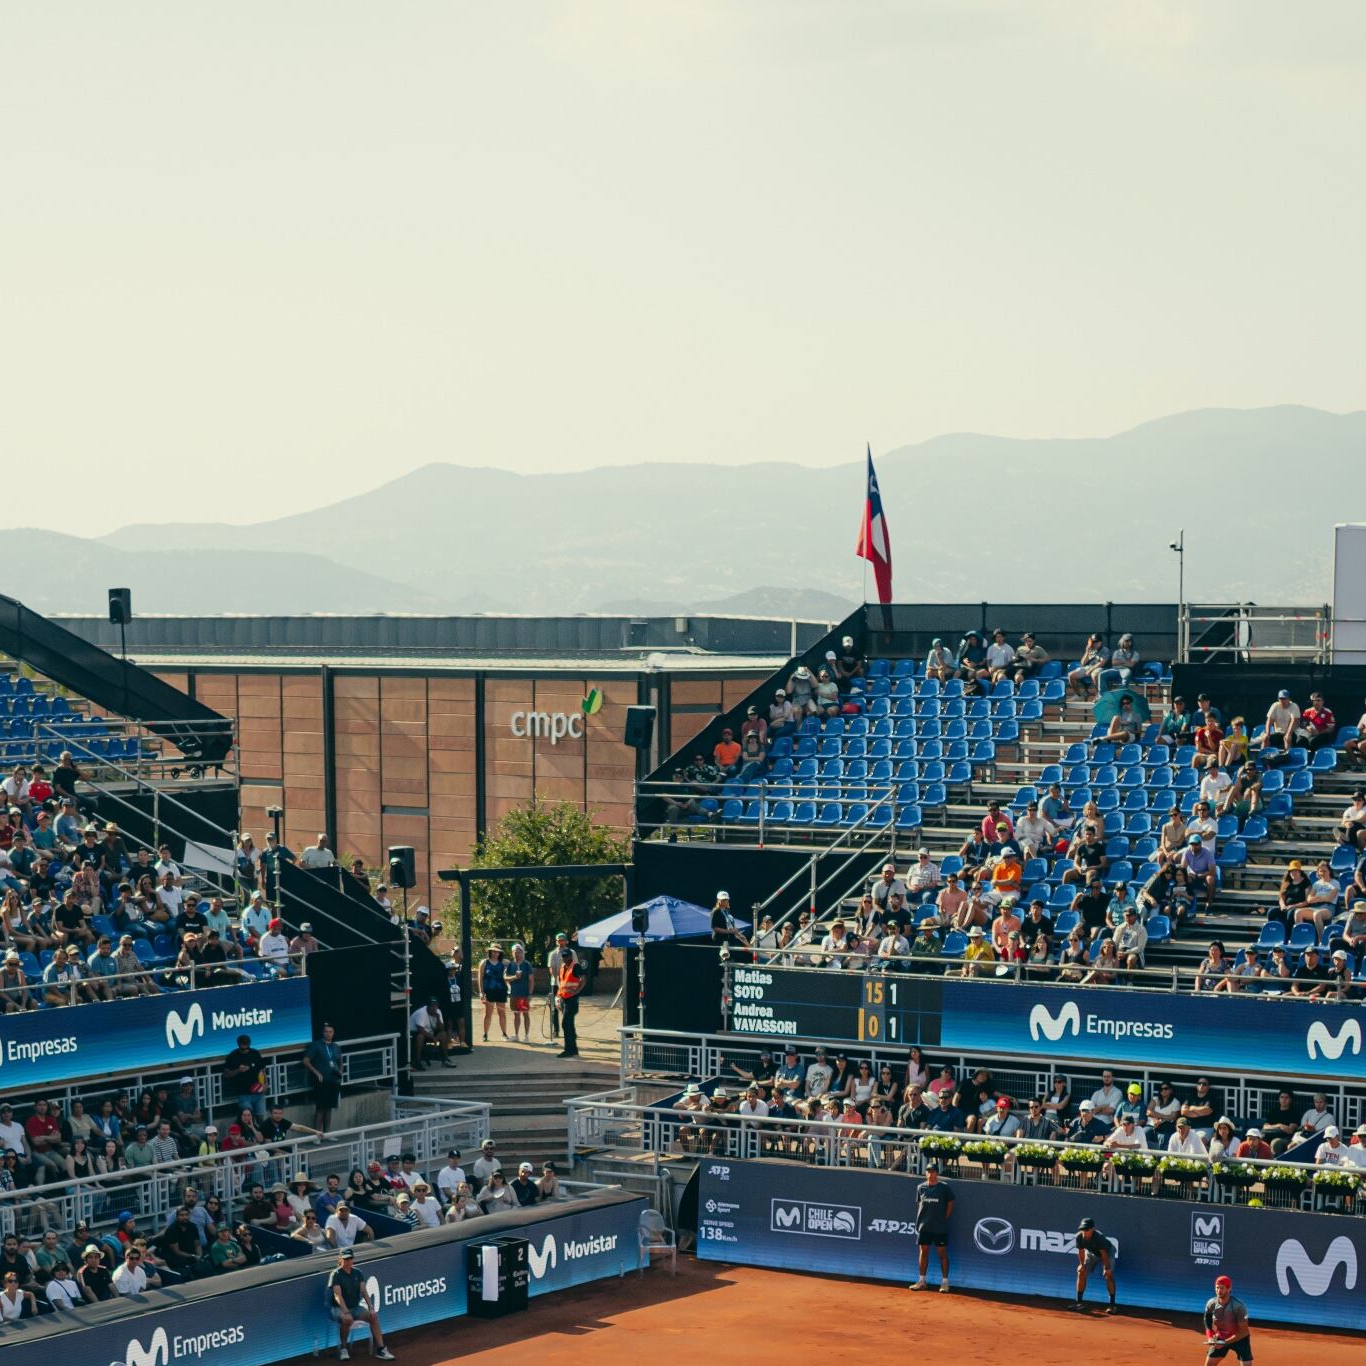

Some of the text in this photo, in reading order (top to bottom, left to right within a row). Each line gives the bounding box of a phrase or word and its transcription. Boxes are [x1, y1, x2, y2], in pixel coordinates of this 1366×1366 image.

[511, 711, 583, 746] cmpc
[735, 969, 773, 985] Matias
[734, 981, 897, 1005] SOTO 15 1
[211, 1007, 273, 1031] Movistar
[734, 1002, 773, 1018] Andrea
[734, 1015, 897, 1039] VAVASSORI 0 1
[1086, 1014, 1174, 1041] Empresas
[7, 1036, 78, 1063] Empresas
[708, 1166, 730, 1175] ATP
[808, 1207, 833, 1220] CHILE
[808, 1219, 833, 1231] OPEN
[563, 1234, 618, 1261] Movistar
[385, 1277, 447, 1306] Empresas
[173, 1325, 245, 1357] Empresas
